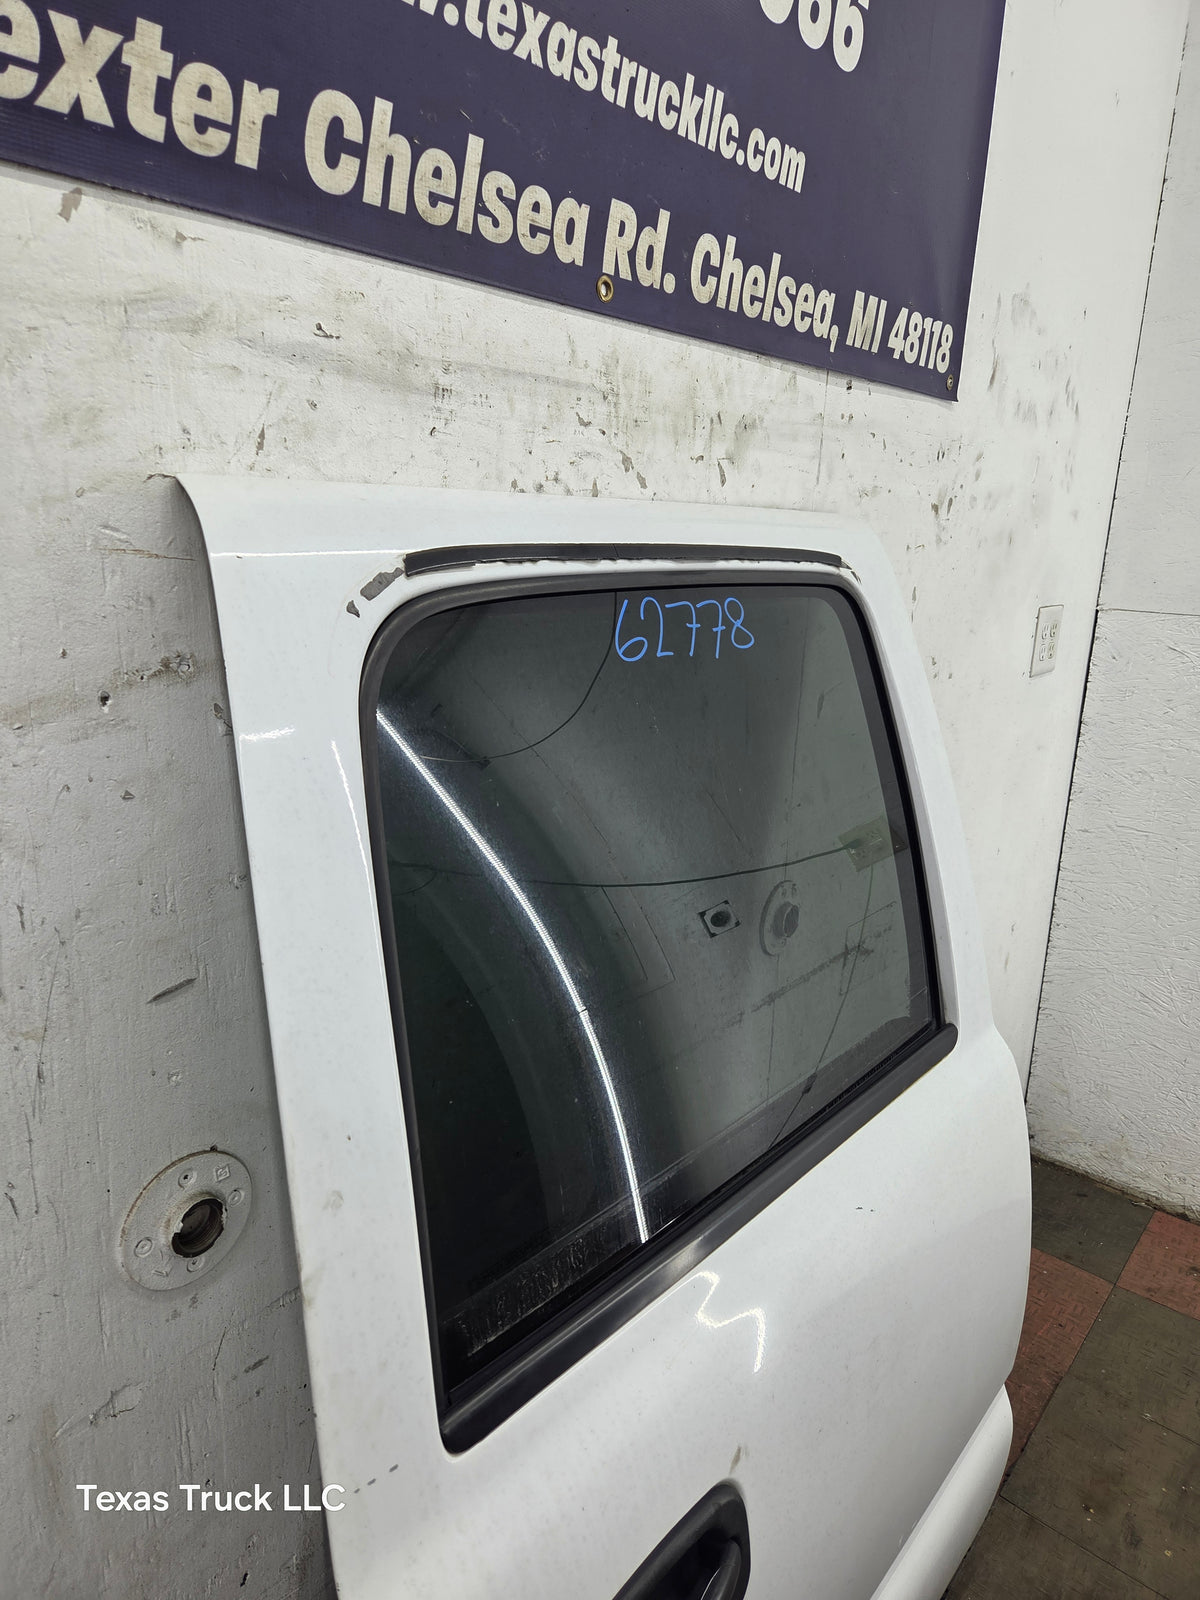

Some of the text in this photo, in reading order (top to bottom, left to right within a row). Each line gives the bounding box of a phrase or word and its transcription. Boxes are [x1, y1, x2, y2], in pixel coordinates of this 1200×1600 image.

[304, 89, 590, 267] Chelsea
[602, 198, 676, 294] Rd.
[690, 232, 839, 353] Chelsea,
[845, 289, 888, 354] MI
[887, 306, 954, 374] 48118
[615, 596, 755, 662] 62778
